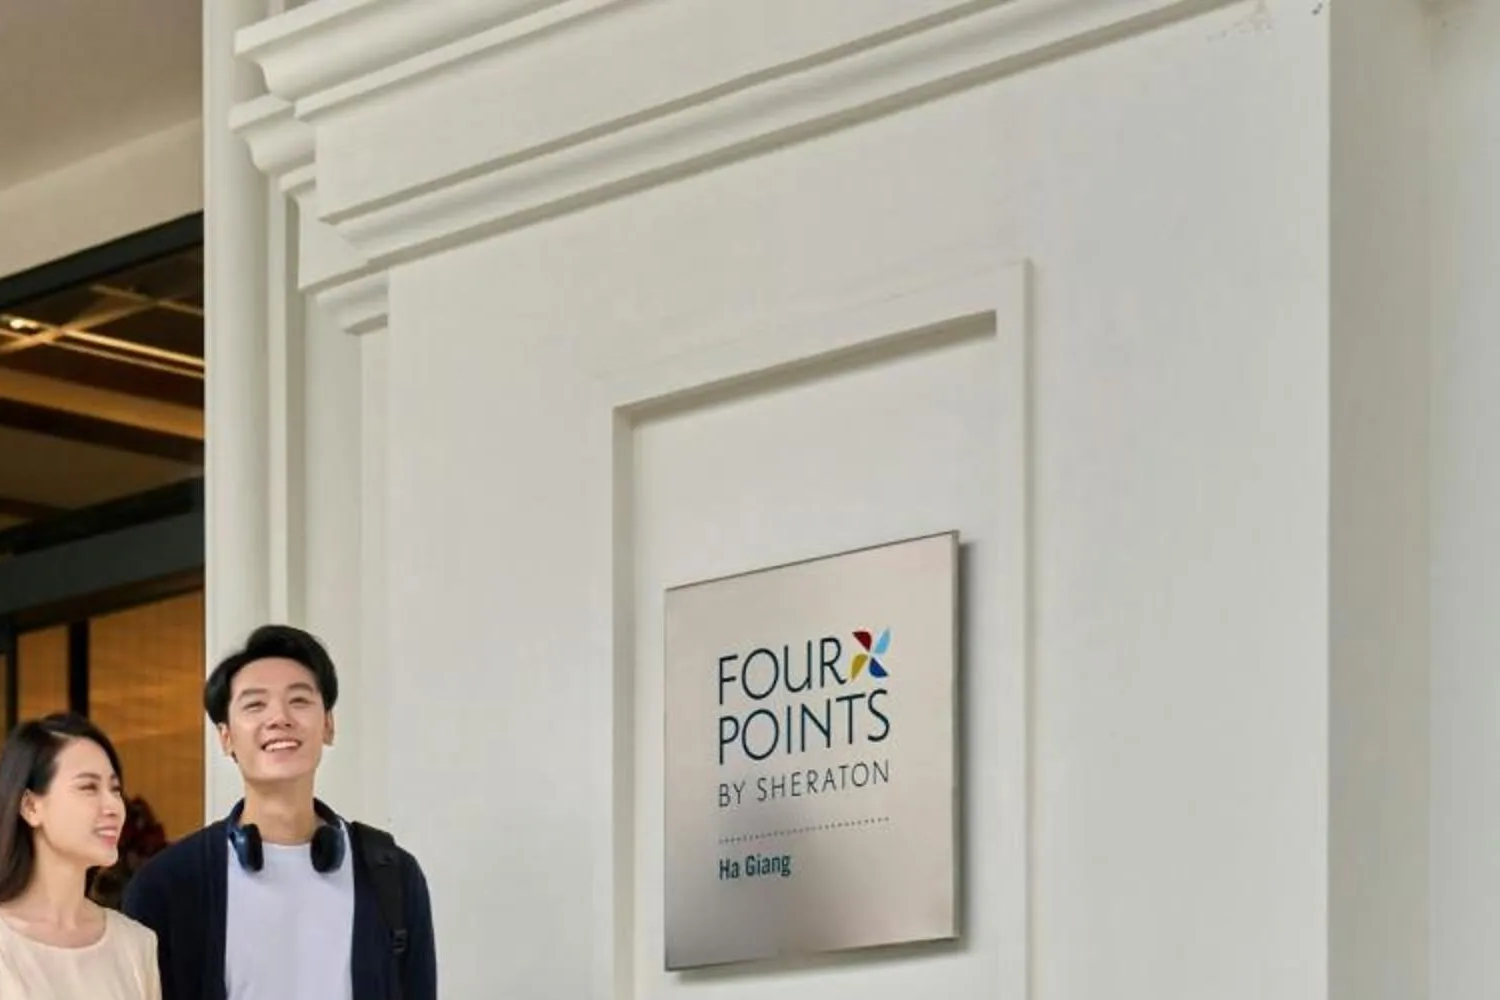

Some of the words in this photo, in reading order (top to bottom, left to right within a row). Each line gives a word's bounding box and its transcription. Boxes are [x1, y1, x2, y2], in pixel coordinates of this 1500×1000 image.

[718, 636, 848, 705] FOUR
[718, 688, 891, 765] POINTS
[718, 780, 746, 808] BY
[757, 759, 890, 802] SHERATON
[718, 857, 740, 880] Ha
[744, 853, 791, 878] Giang
